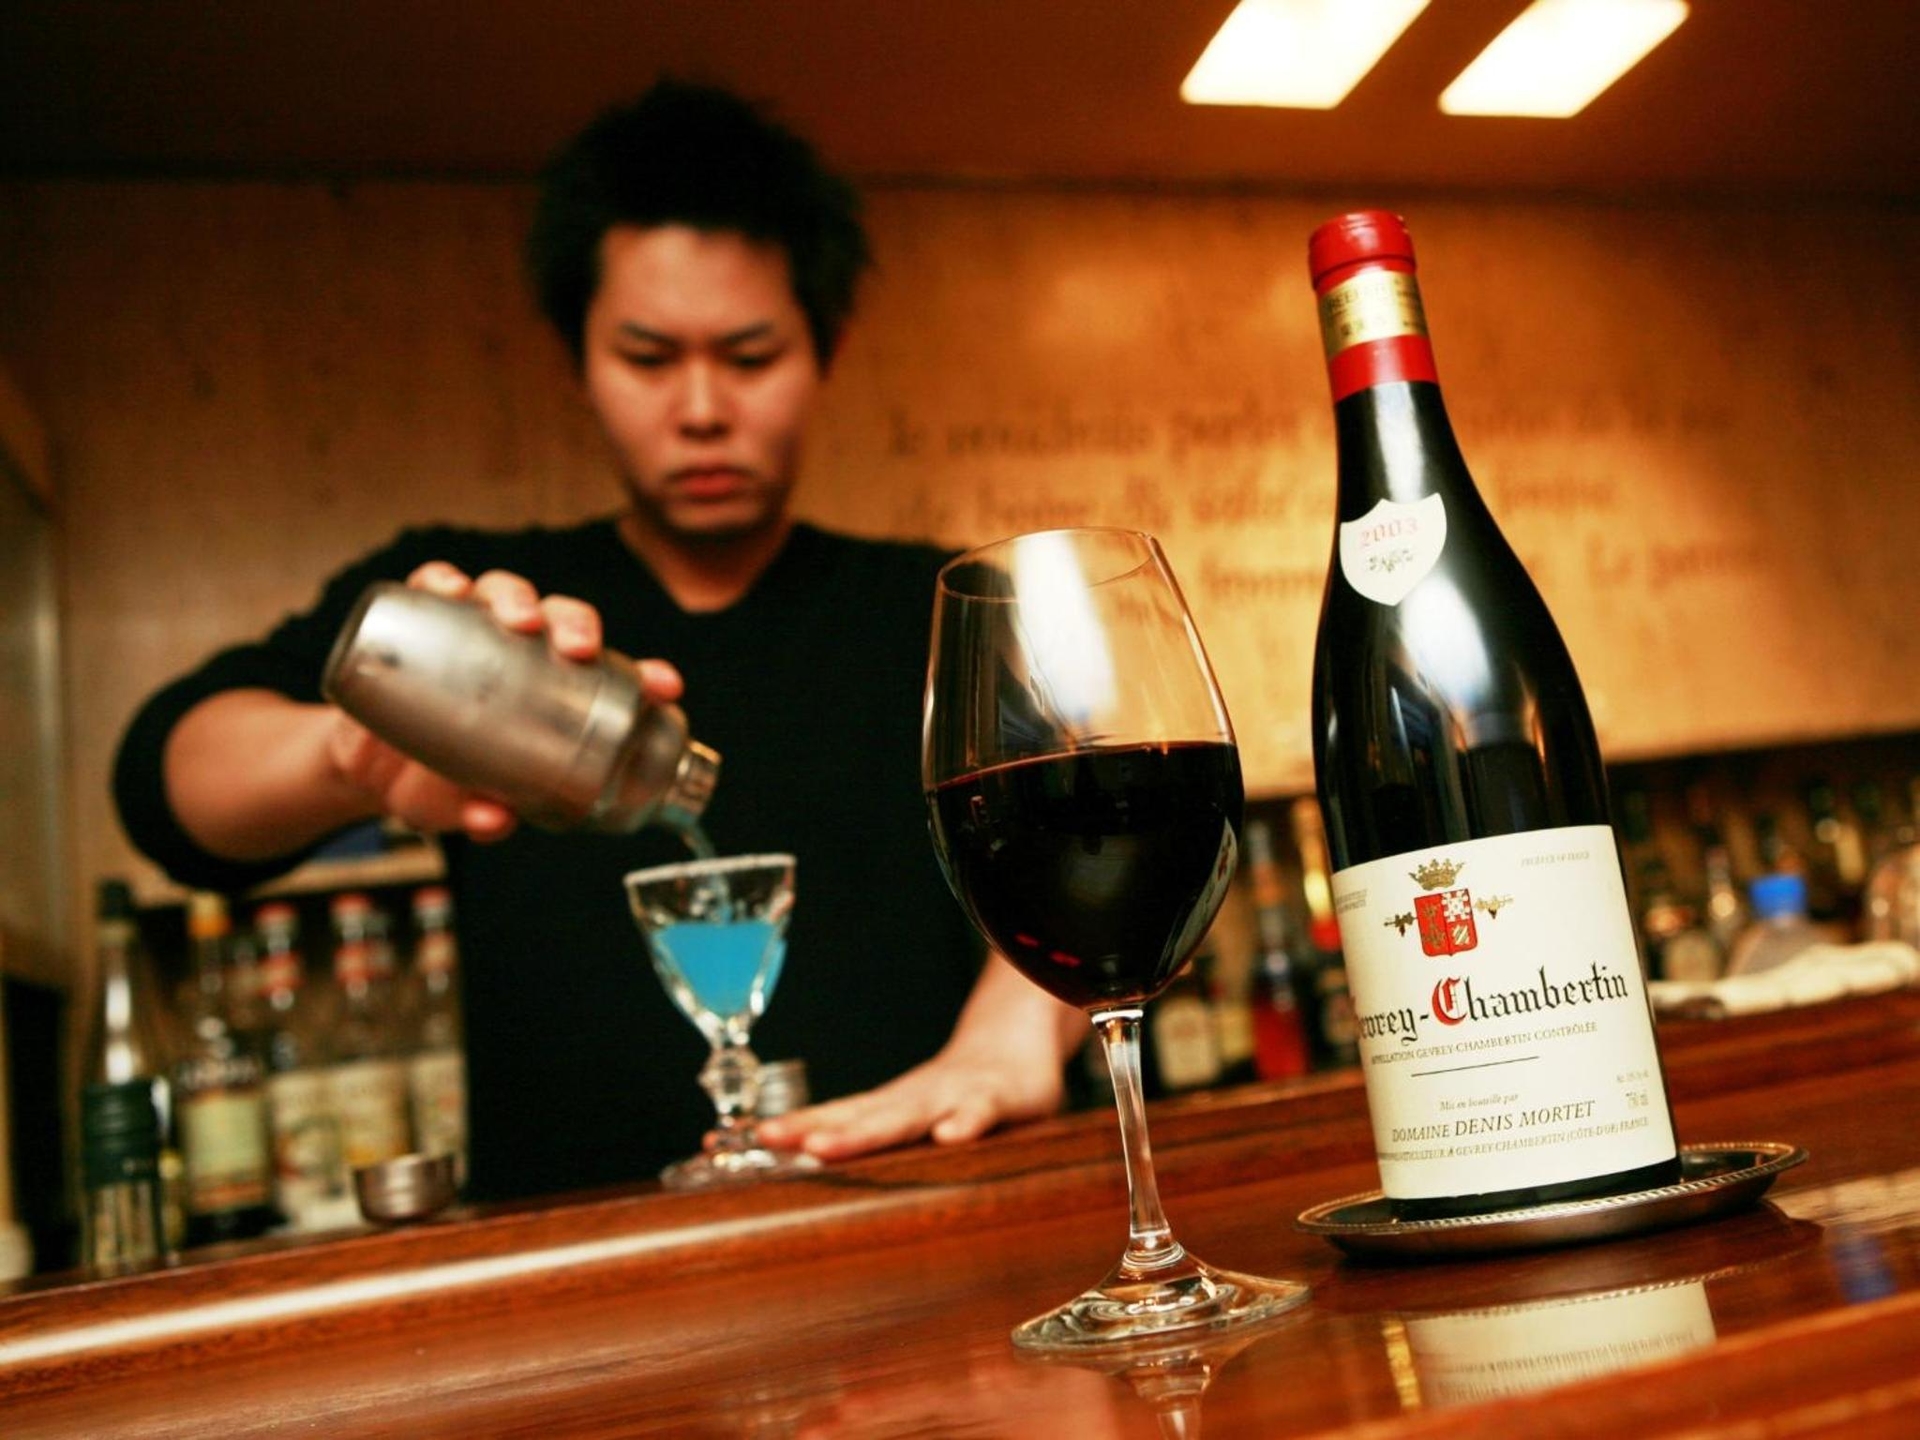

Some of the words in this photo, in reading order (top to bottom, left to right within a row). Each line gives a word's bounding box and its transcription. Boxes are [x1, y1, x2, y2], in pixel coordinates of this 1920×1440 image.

[1360, 516, 1419, 547] 2003
[1357, 961, 1629, 1047] evrey-Chambertin
[1371, 1050, 1415, 1065] APPELLATION
[1534, 1021, 1598, 1042] CONTRÔLÉE
[1392, 1124, 1451, 1143] DOMAINE
[1455, 1113, 1513, 1137] DENIS
[1518, 1099, 1596, 1127] MORTET
[1503, 1093, 1519, 1105] par
